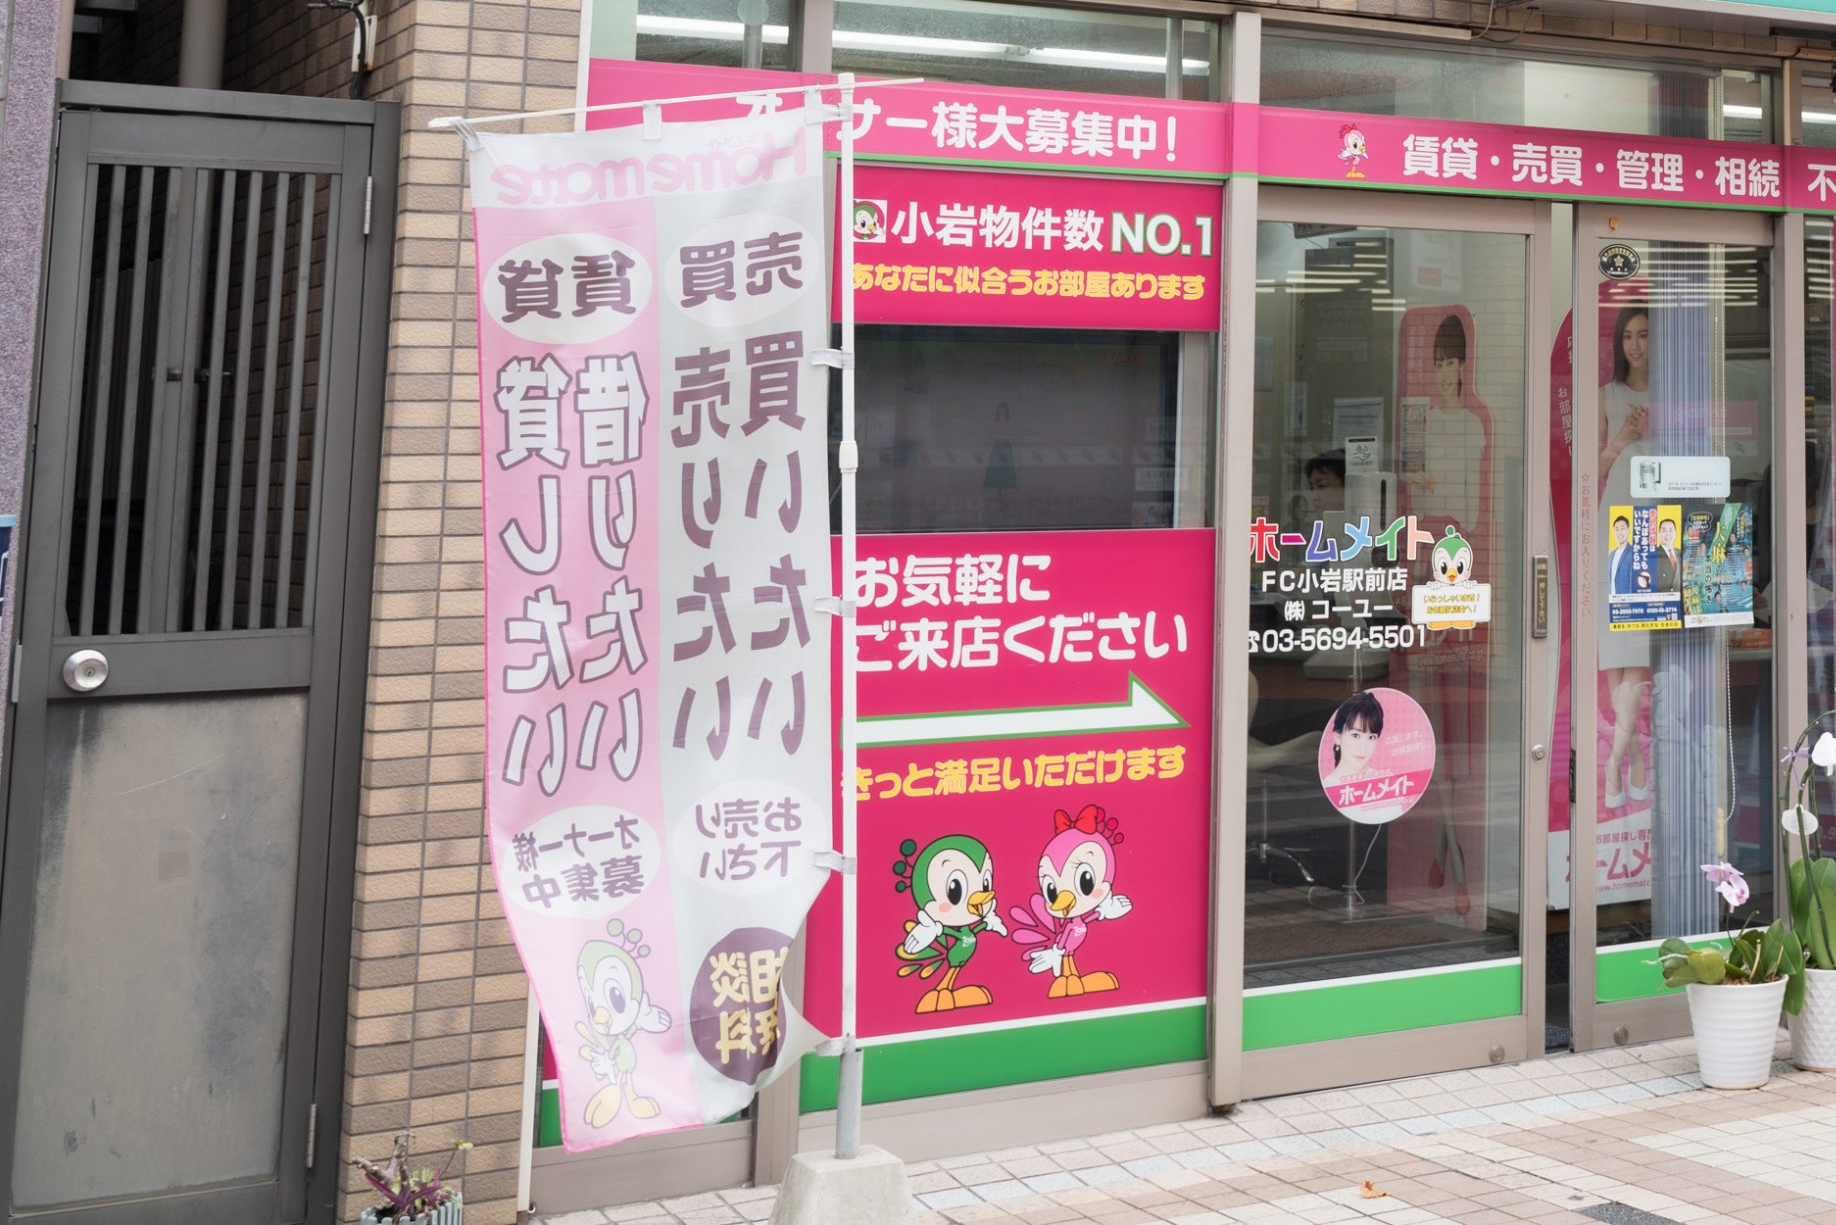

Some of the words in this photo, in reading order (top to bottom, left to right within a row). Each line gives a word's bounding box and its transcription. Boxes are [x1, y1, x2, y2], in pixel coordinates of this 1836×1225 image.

[736, 92, 1177, 163] オナー様大募集中!
[853, 262, 1206, 302] あなたに似合うお部屋あります
[1249, 515, 1435, 564] ホームメイト
[856, 553, 1052, 608] お気軽に
[1261, 566, 1408, 593] FC小岩駅前店
[1311, 599, 1393, 620] コーユー
[856, 611, 1187, 672] ご来店ください
[1262, 624, 1425, 652] 03-5694-5501
[841, 745, 1187, 800] きっと満足いただけます
[1338, 776, 1415, 806] ホームメイト
